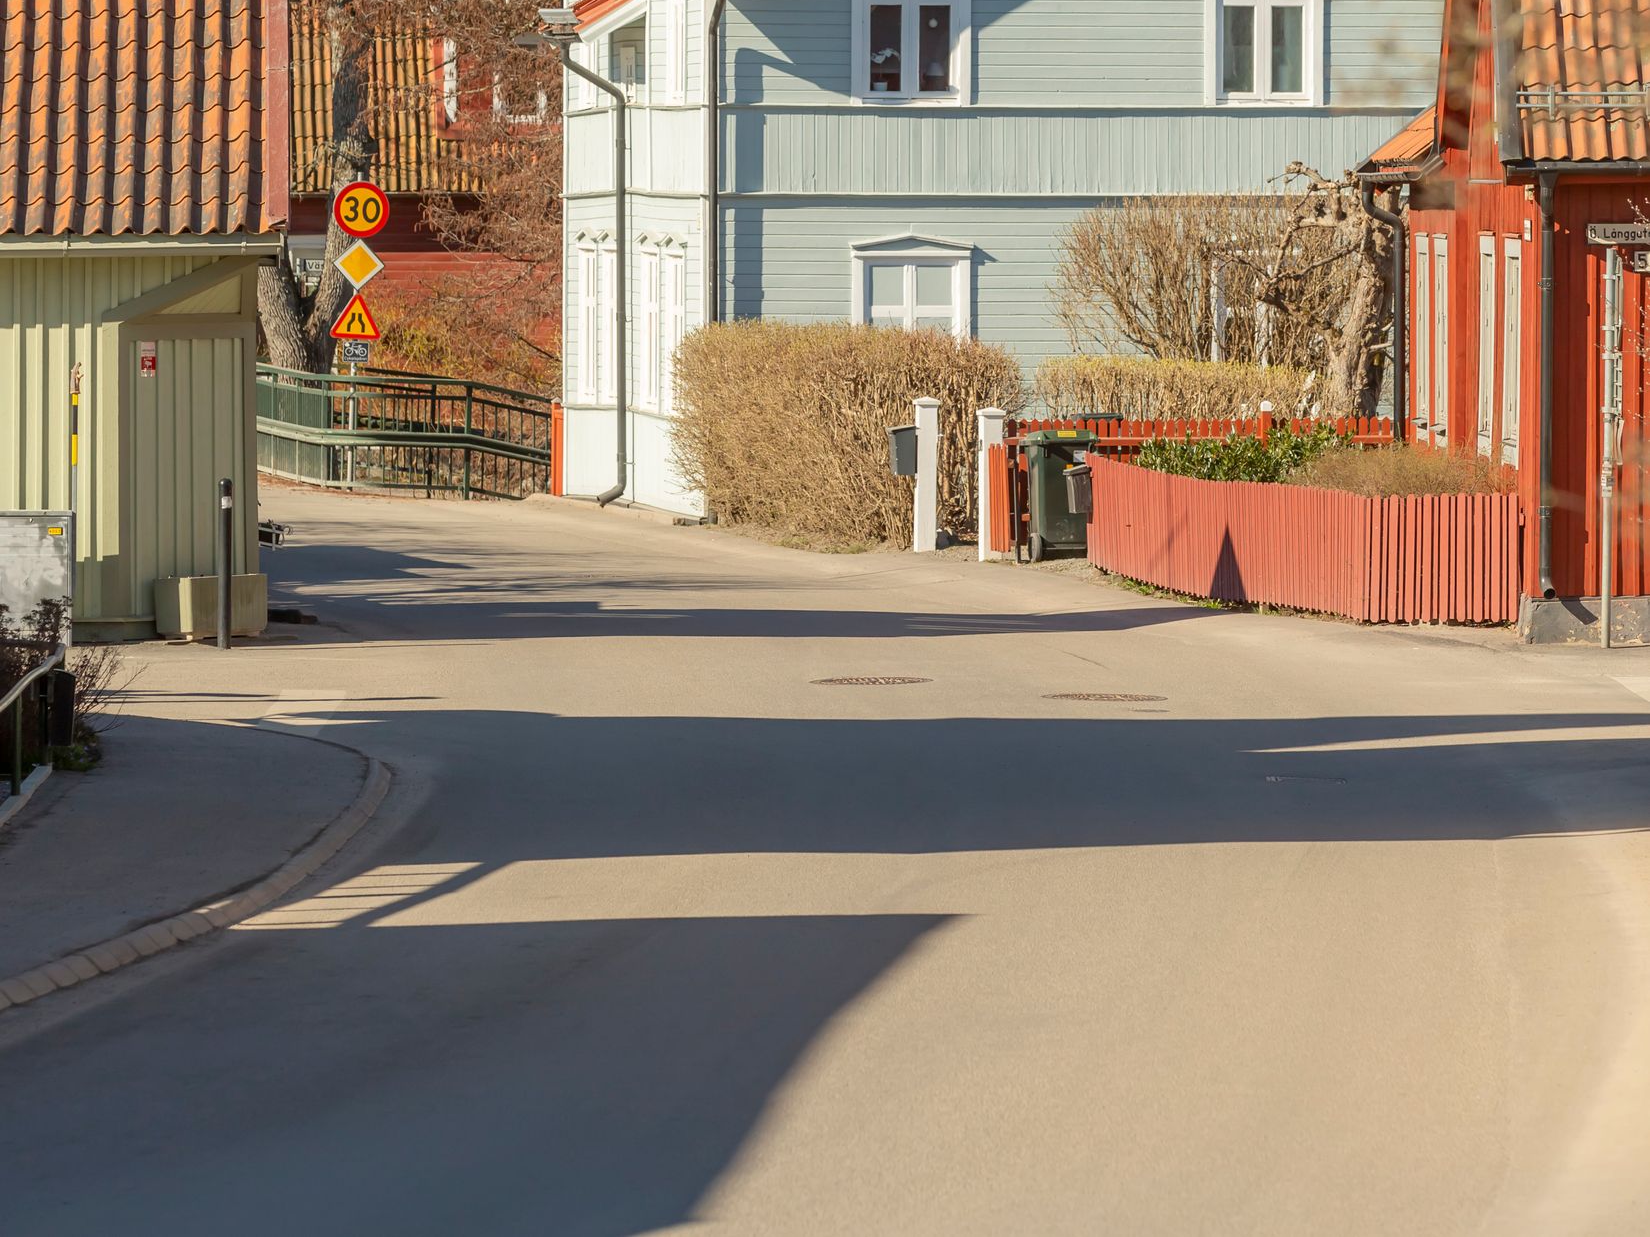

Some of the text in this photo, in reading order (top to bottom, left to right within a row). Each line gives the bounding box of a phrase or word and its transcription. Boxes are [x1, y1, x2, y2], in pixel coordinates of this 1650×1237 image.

[344, 196, 381, 223] 30
[1590, 225, 1600, 238] Ö.
[1637, 253, 1648, 269] 5
